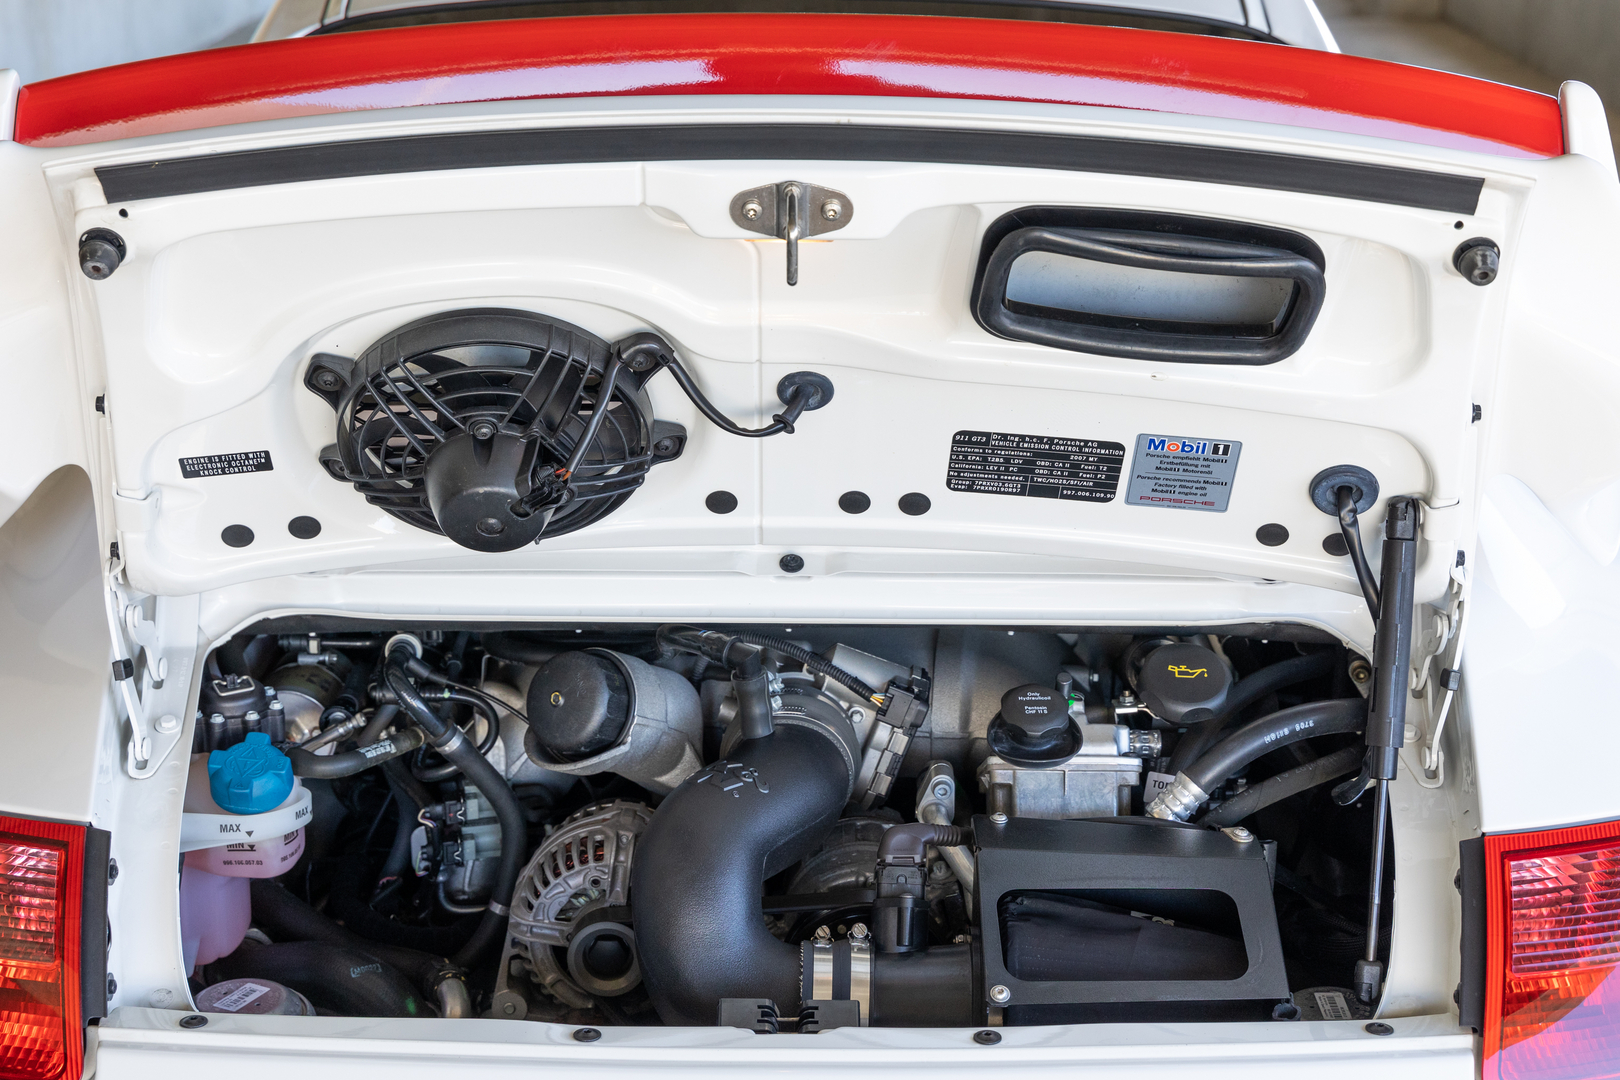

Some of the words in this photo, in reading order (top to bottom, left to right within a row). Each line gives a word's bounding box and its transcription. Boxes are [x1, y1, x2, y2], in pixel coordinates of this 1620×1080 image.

[1054, 438, 1085, 446] Porsche
[1147, 438, 1208, 455] Mobil
[994, 449, 1033, 457] regulations:
[1019, 442, 1050, 450] EMISSION
[1051, 444, 1080, 452] CONTROL
[1082, 447, 1124, 456] INFORMATION
[183, 456, 209, 465] ENGINE
[221, 453, 246, 461] FITTED
[248, 451, 266, 459] WITH
[186, 461, 229, 471] ELECTRONIC
[1159, 460, 1199, 468] Erstbefüllung
[200, 468, 222, 476] KNOCK
[224, 465, 256, 474] CONTROL
[960, 471, 998, 479] adjustments
[1063, 489, 1115, 499] 997.006.109.90
[1139, 496, 1215, 506] PORSCHE
[295, 805, 309, 820] MAX
[220, 824, 241, 833] MAX
